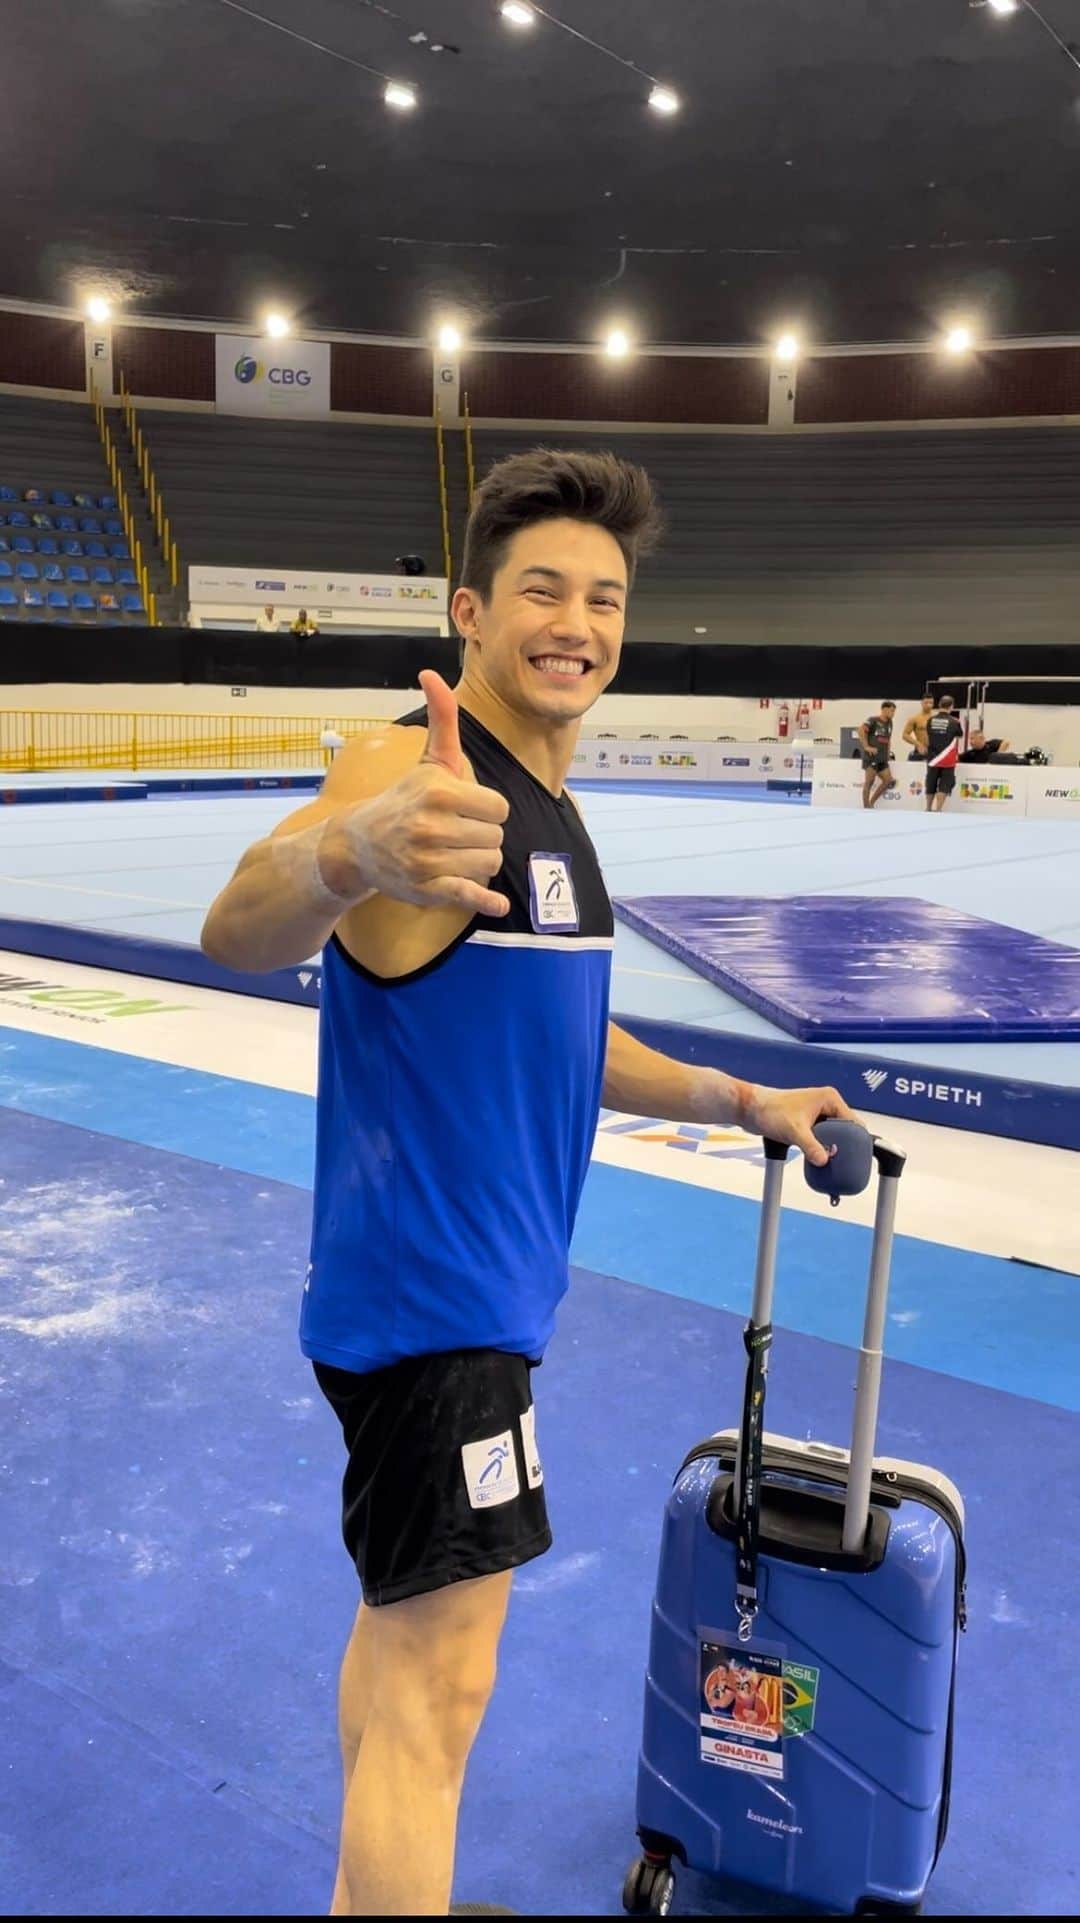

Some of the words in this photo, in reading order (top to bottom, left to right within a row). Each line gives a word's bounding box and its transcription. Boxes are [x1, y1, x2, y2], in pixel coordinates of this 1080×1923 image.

[94, 342, 105, 356] F
[267, 367, 312, 386] CBG
[441, 369, 454, 383] G
[895, 1078, 982, 1107] SPIETH
[783, 1664, 816, 1683] ASIL
[714, 1742, 769, 1763] GINASTA
